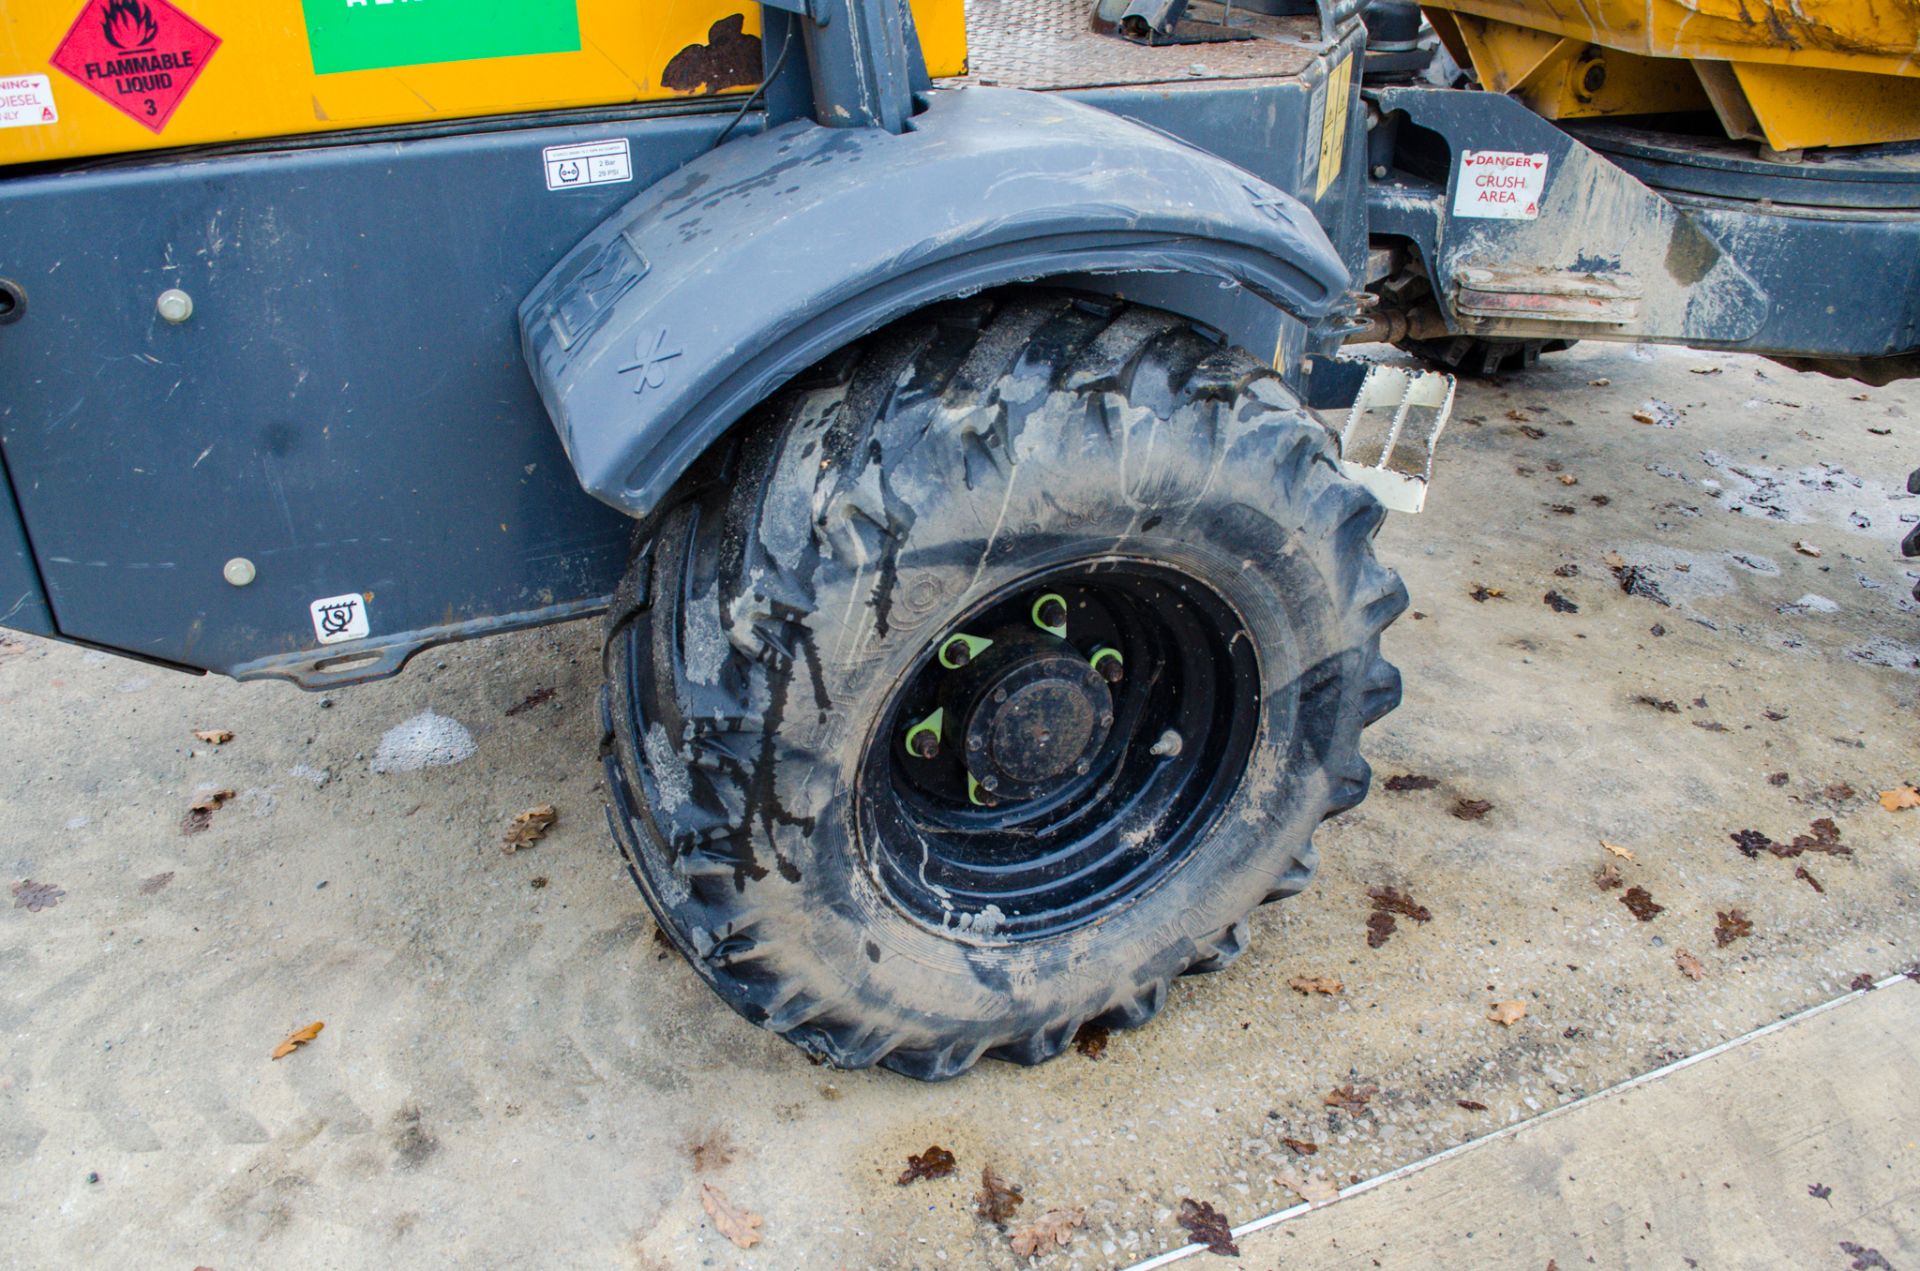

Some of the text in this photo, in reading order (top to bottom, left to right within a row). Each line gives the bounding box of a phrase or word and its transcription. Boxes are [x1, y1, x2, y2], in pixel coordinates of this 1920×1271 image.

[85, 50, 193, 80] FLAMMABLE
[116, 73, 172, 94] LIQUID
[144, 98, 157, 116] 3
[1476, 155, 1531, 167] DANGER
[1475, 175, 1525, 188] CRUSH
[1477, 190, 1516, 203] AREA
